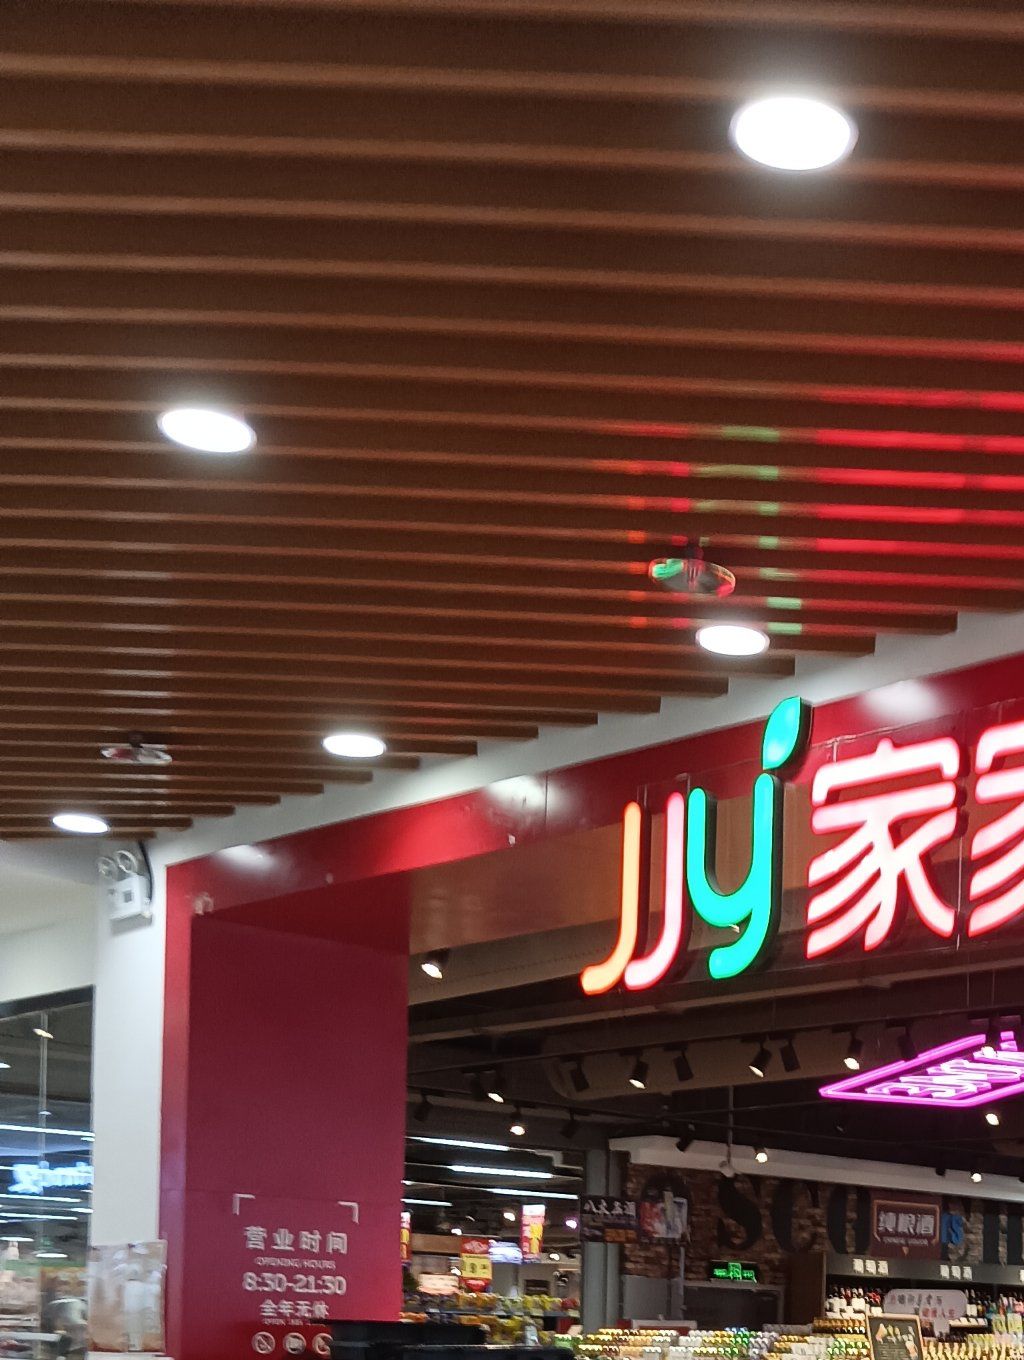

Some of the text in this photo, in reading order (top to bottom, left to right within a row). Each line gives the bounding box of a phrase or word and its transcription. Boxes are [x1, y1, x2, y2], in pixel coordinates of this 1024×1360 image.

[243, 1225, 348, 1254] 营业时间
[242, 1271, 348, 1296] 8:30-21:30
[259, 1299, 330, 1318] 全年无休
